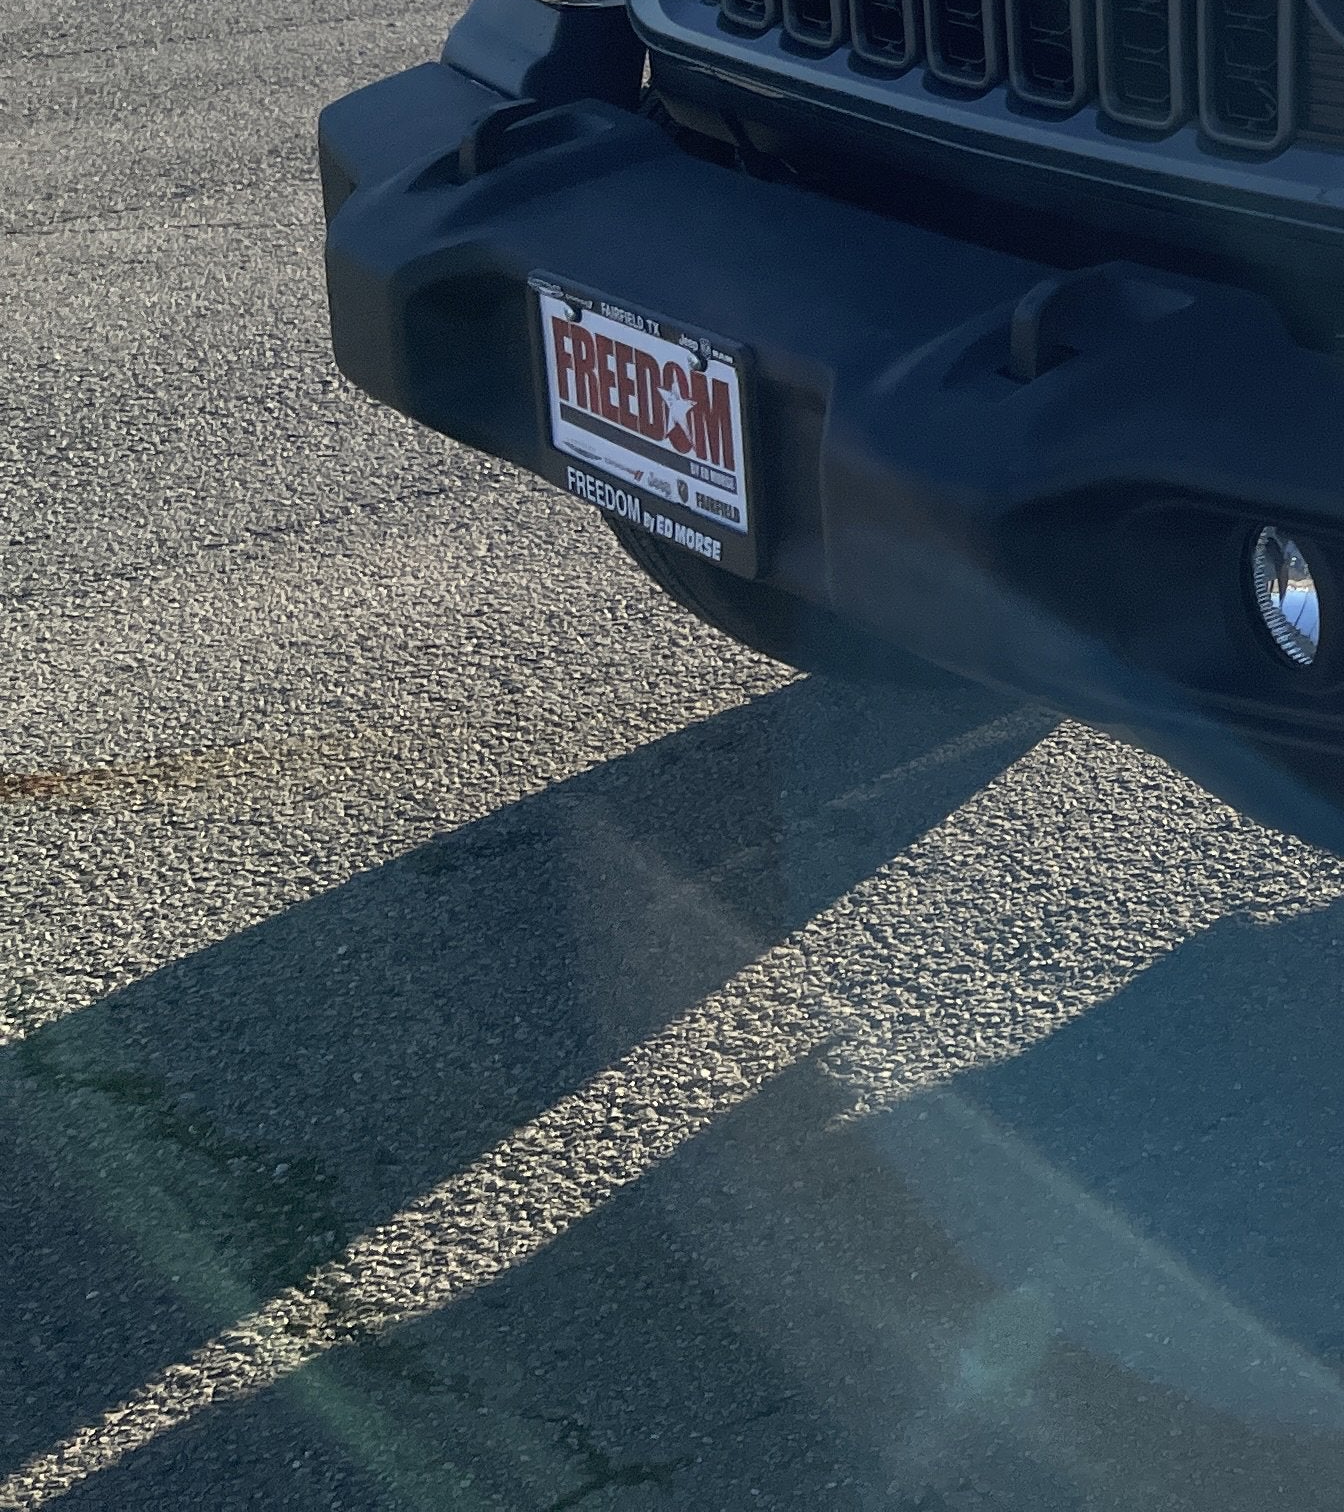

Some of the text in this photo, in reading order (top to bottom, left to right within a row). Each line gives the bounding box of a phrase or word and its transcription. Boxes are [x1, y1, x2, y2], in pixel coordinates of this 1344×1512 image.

[647, 318, 661, 337] TX
[551, 315, 736, 473] FREEDOM
[567, 465, 641, 524] FREEDOM
[655, 514, 673, 541] ED
[674, 523, 722, 562] MORSE
